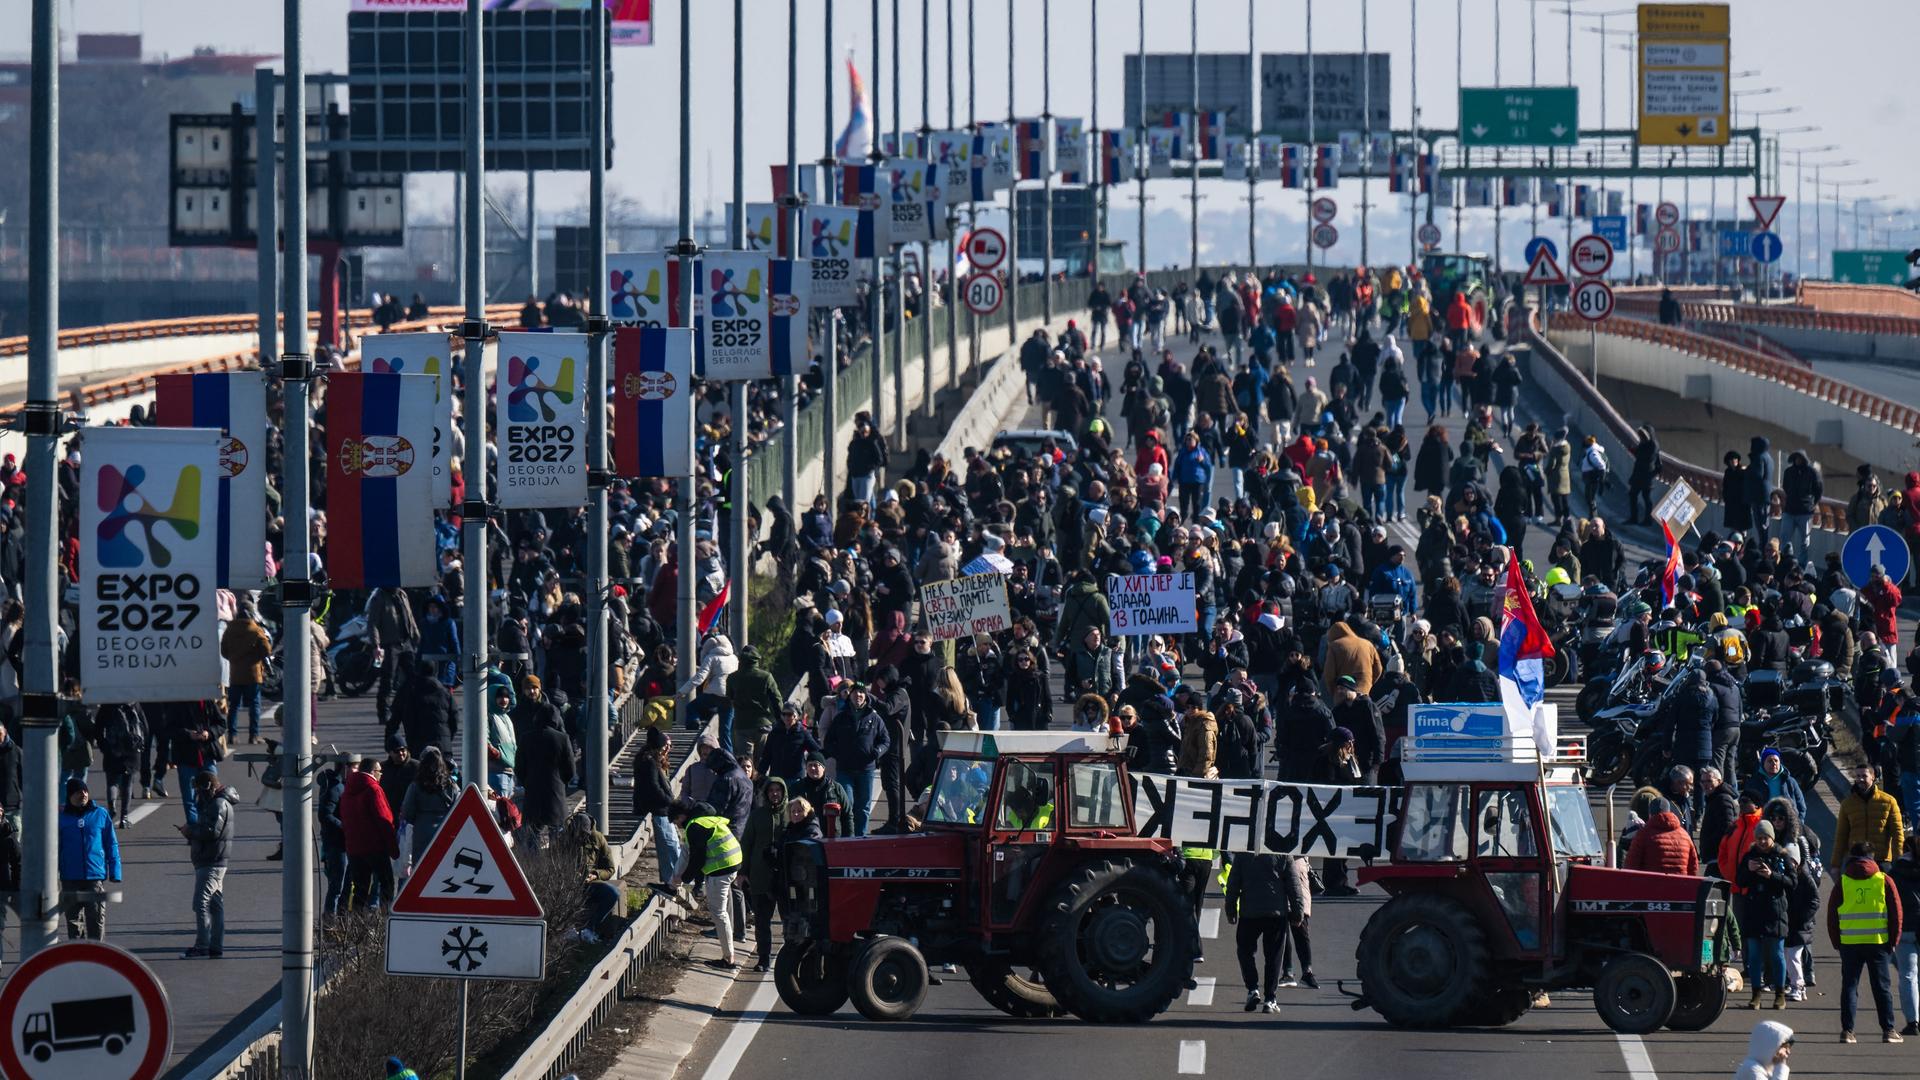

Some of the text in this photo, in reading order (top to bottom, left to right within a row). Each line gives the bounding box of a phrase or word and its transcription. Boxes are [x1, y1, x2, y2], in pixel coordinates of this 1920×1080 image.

[812, 259, 849, 269] EXPO
[812, 270, 849, 280] 2027
[972, 284, 995, 306] 80
[1580, 290, 1607, 312] 80
[712, 319, 761, 333] EXPO
[712, 334, 761, 347] 2027
[508, 425, 574, 443] EXPO
[508, 444, 574, 462] 2027
[508, 465, 576, 475] BEOGRAD
[508, 476, 560, 487] SRBIJA
[97, 573, 200, 600] EXPO
[924, 572, 1003, 600] НЕК БУЛЕВАРИ
[1109, 573, 1194, 593] И ХИТЛЕР ЈЕ
[925, 589, 994, 613] СВЕТА ПАМТЕ
[1109, 592, 1151, 610] ВЛАДАО
[97, 603, 200, 631] 2027
[929, 607, 973, 626] МУЗИКУ
[1113, 606, 1189, 628] 13 ГОДИНА...
[932, 614, 1004, 640] НАШИХ КОРАКА
[97, 636, 203, 650] BEOGRAD
[97, 654, 177, 668] SRBIJA
[1416, 715, 1449, 727] fima
[844, 868, 875, 878] IMT
[907, 869, 930, 877] 577
[1575, 901, 1609, 910] IMT
[1648, 903, 1671, 911] 542
